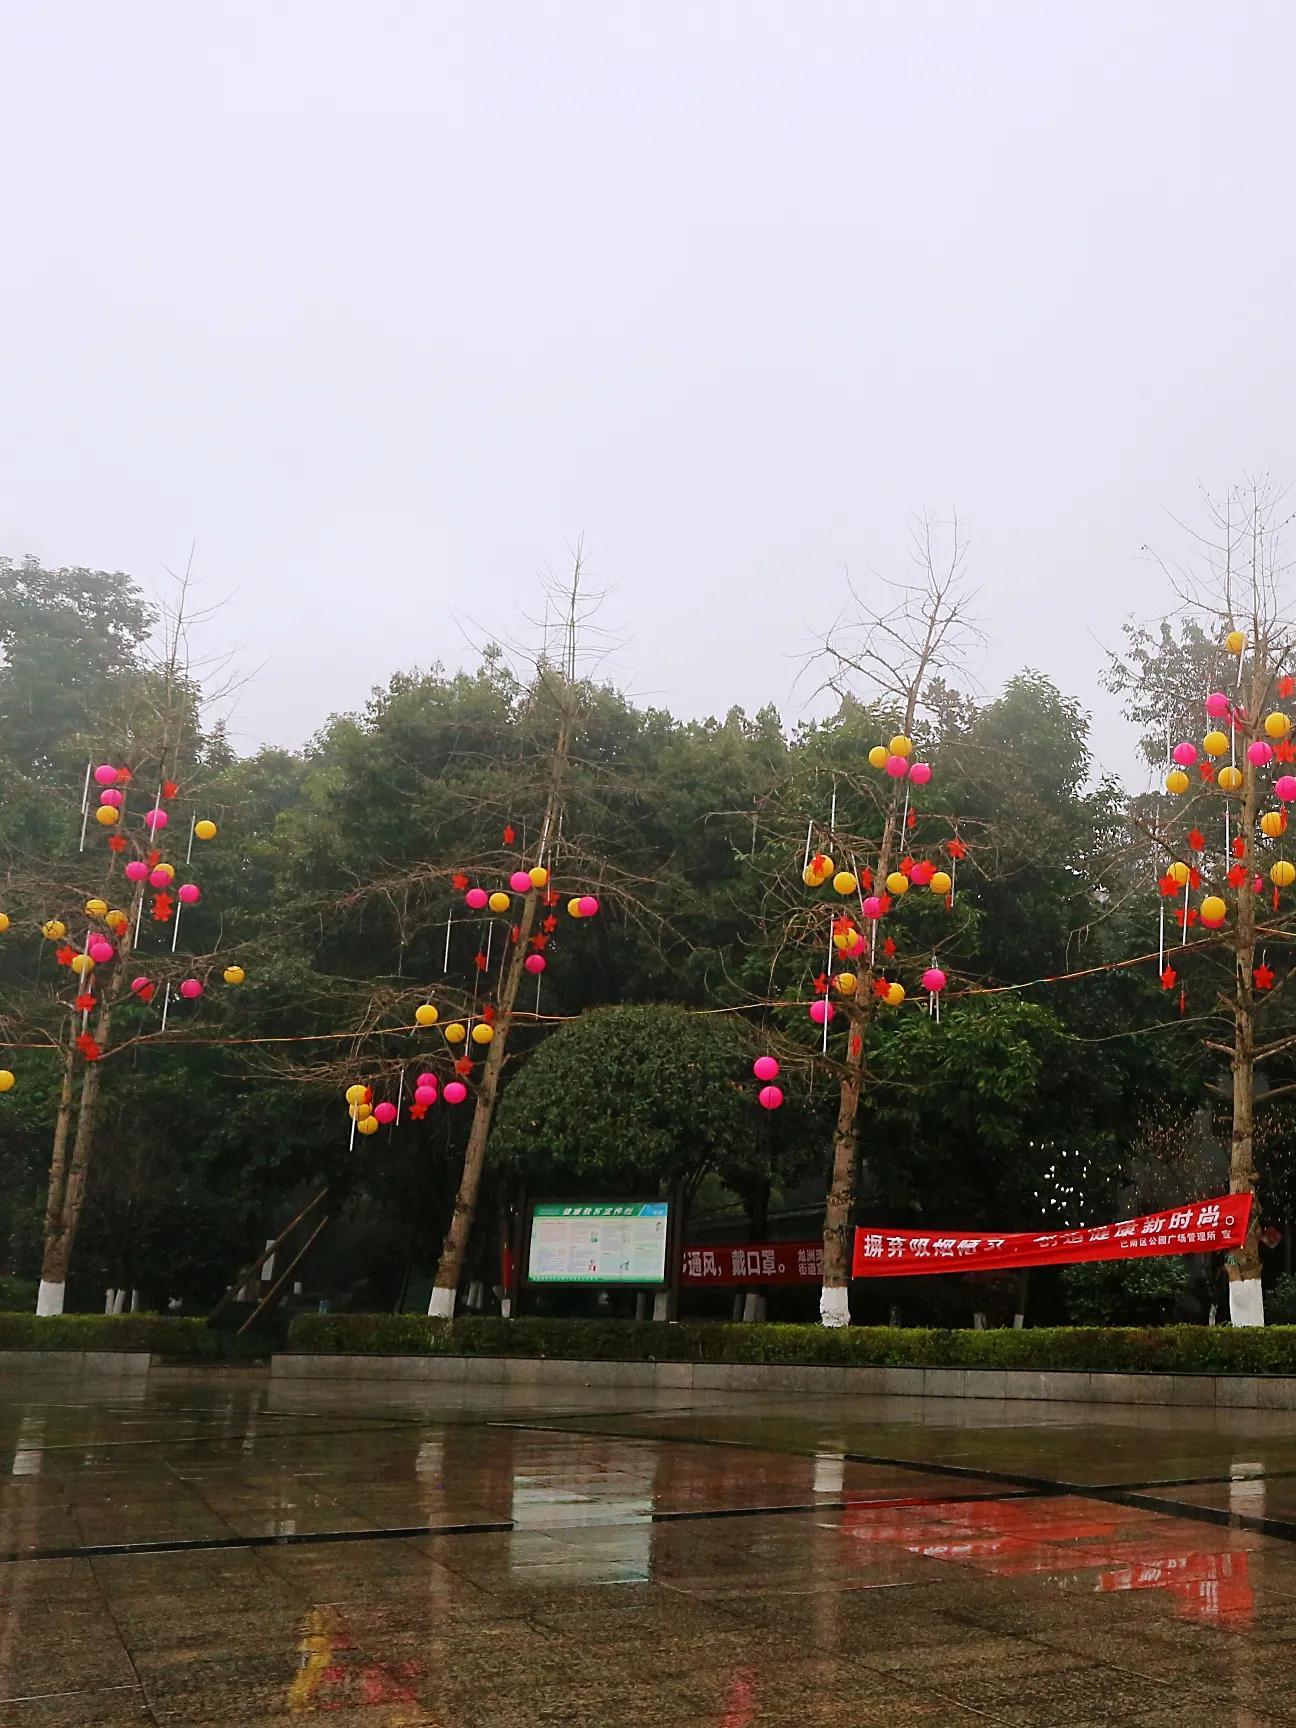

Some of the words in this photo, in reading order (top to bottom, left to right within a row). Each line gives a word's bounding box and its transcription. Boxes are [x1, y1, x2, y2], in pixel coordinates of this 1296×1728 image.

[1120, 1231, 1216, 1249] 巴南区公园广场管理所
